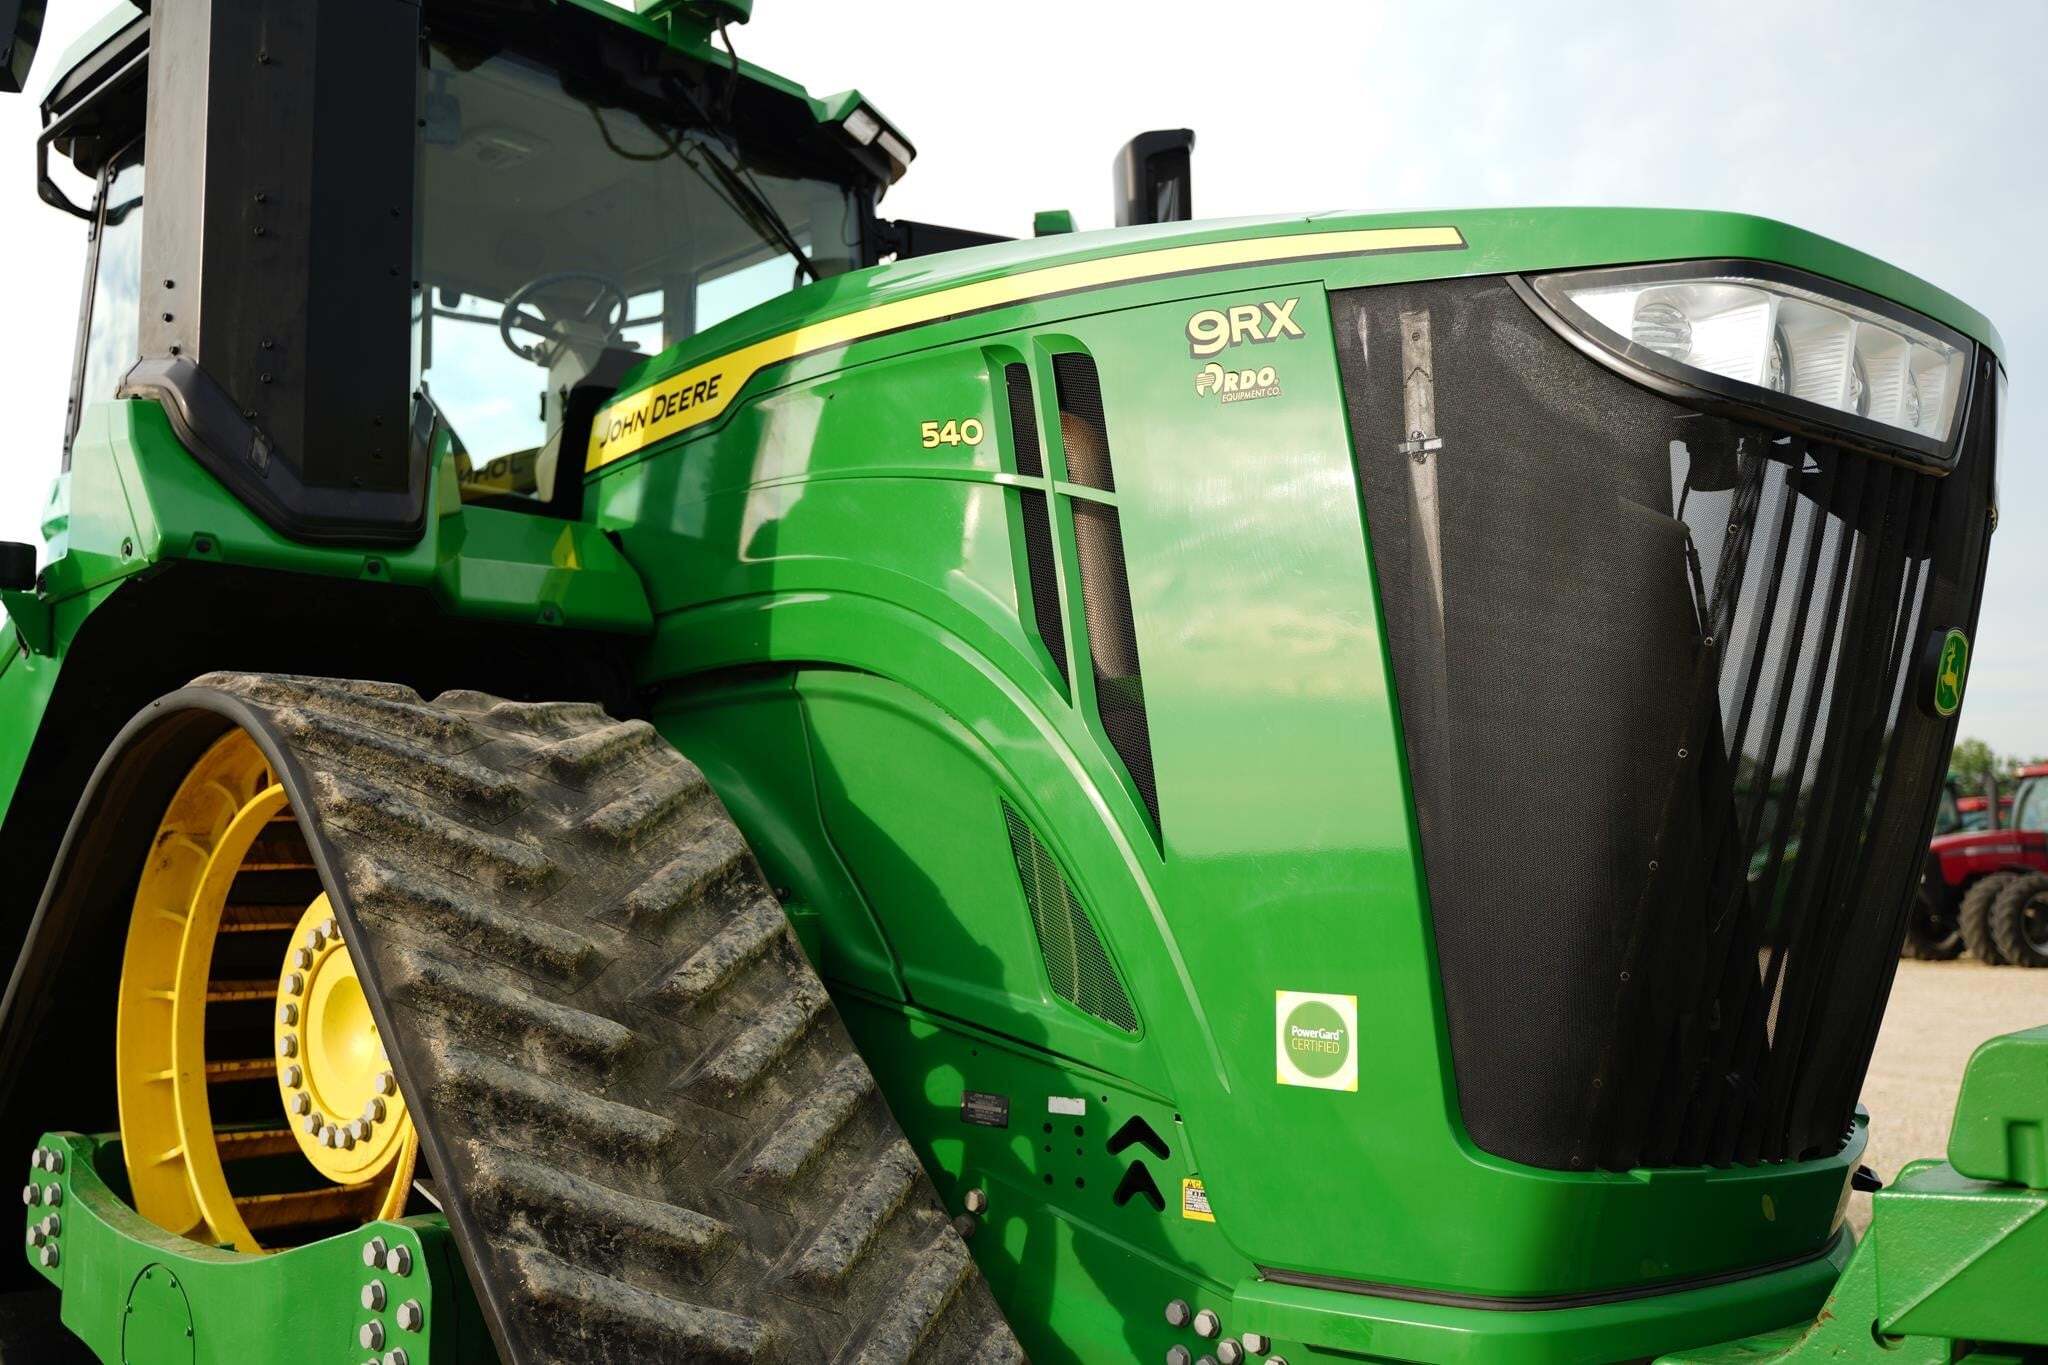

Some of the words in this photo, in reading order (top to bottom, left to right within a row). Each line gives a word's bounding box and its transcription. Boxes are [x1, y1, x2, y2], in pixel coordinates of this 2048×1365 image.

[1185, 297, 1305, 358] 9RX
[1222, 387, 1266, 403] EQUIPMENT
[599, 407, 648, 448] JOHN
[650, 374, 722, 424] DEERE
[920, 417, 984, 448] 540
[1291, 1038, 1340, 1054] CERTIFIED
